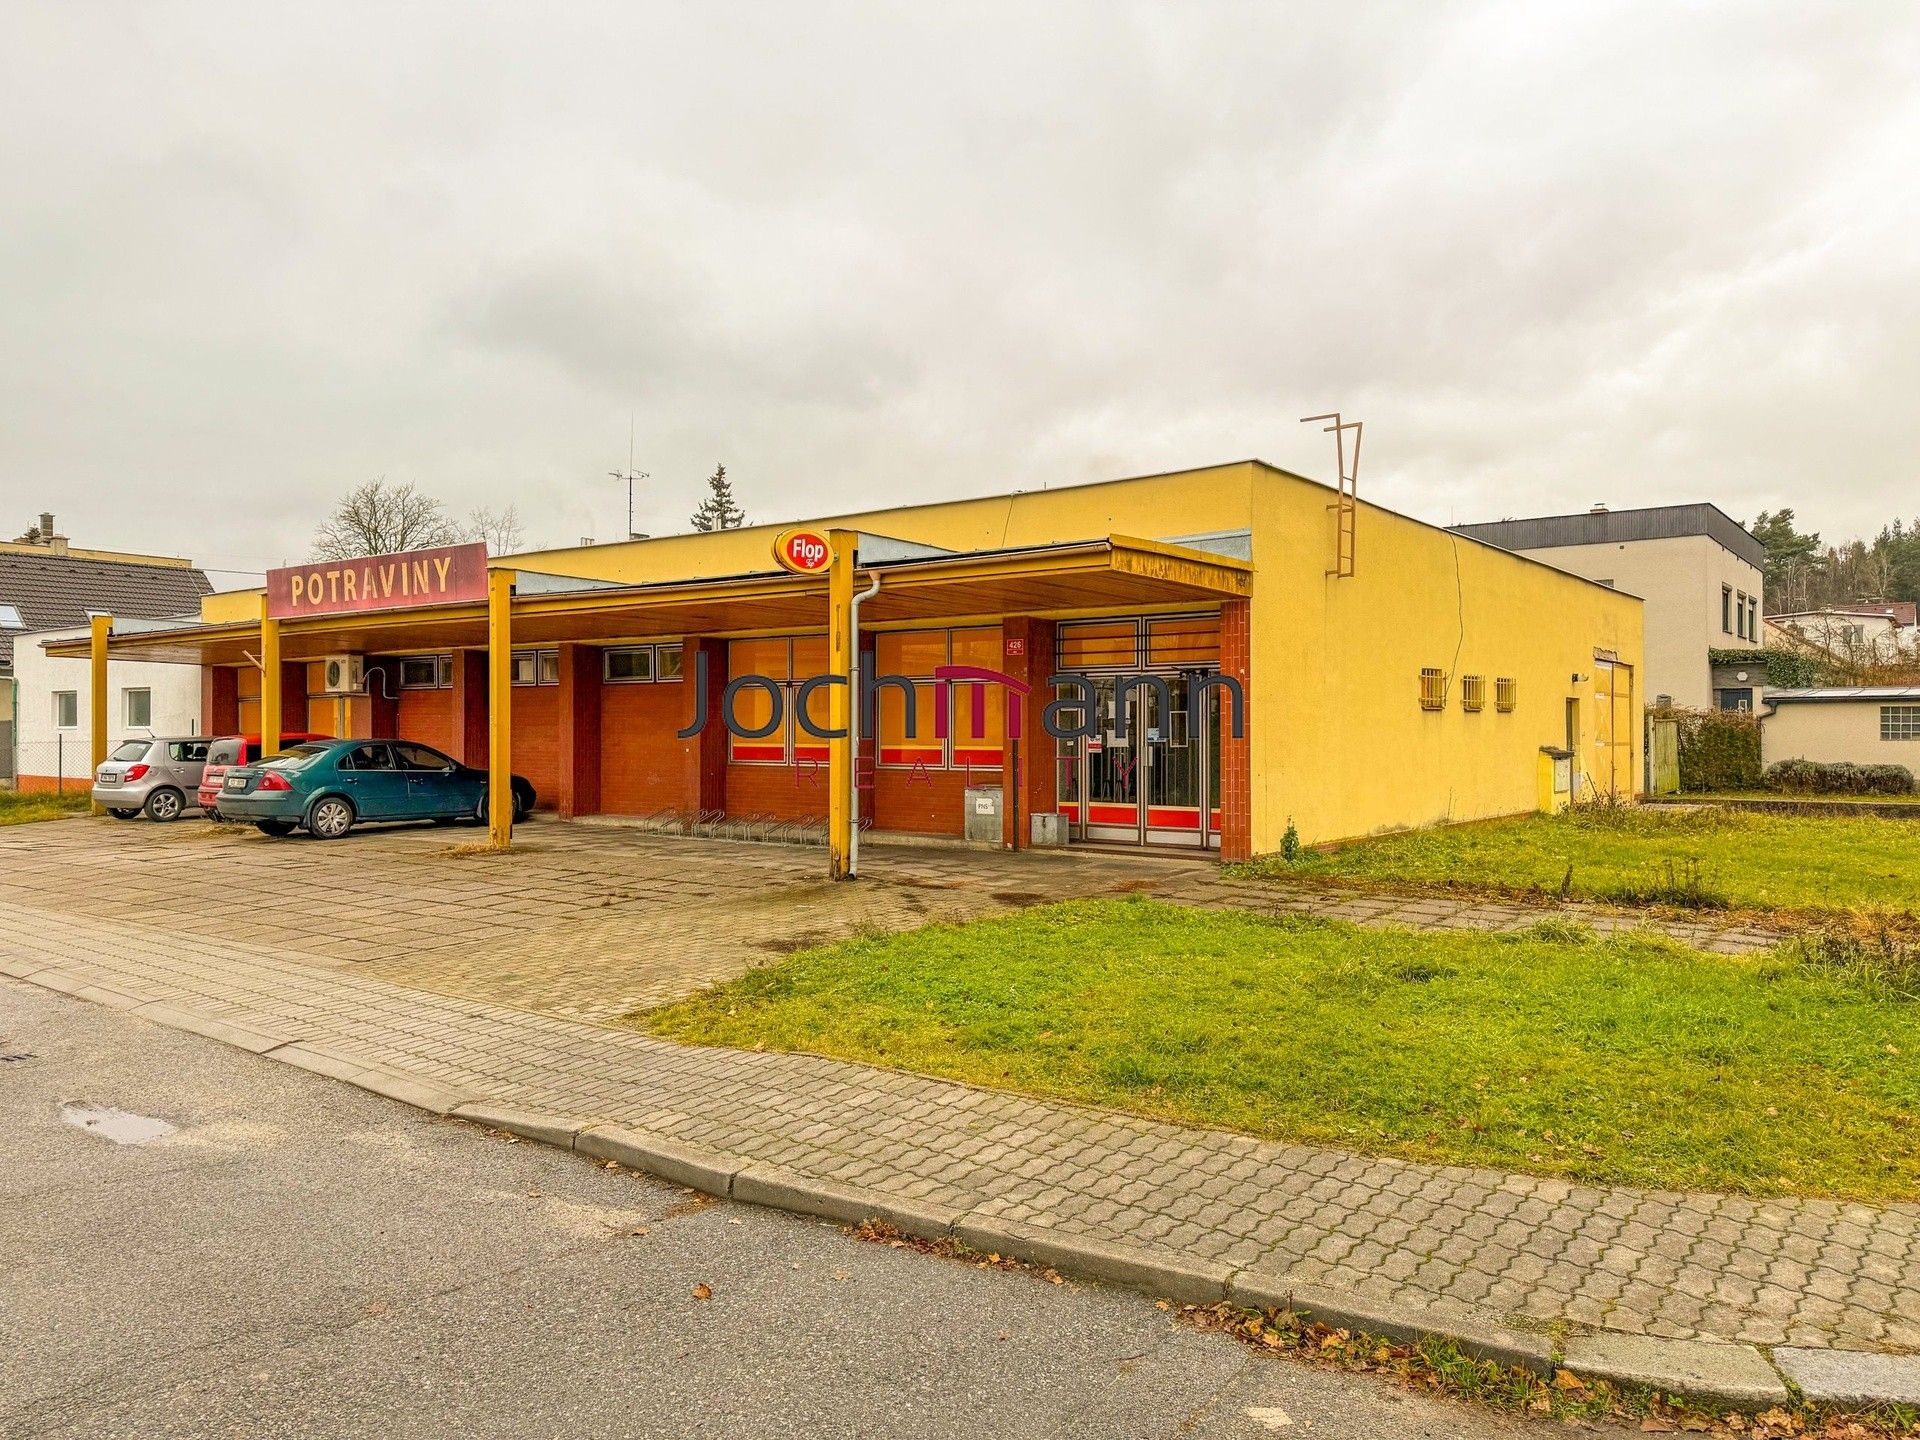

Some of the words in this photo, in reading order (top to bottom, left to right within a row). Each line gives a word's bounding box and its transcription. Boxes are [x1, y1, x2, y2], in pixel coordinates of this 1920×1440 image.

[792, 538, 824, 562] Flop
[291, 556, 452, 607] POTRAVINY
[1009, 640, 1022, 649] 426
